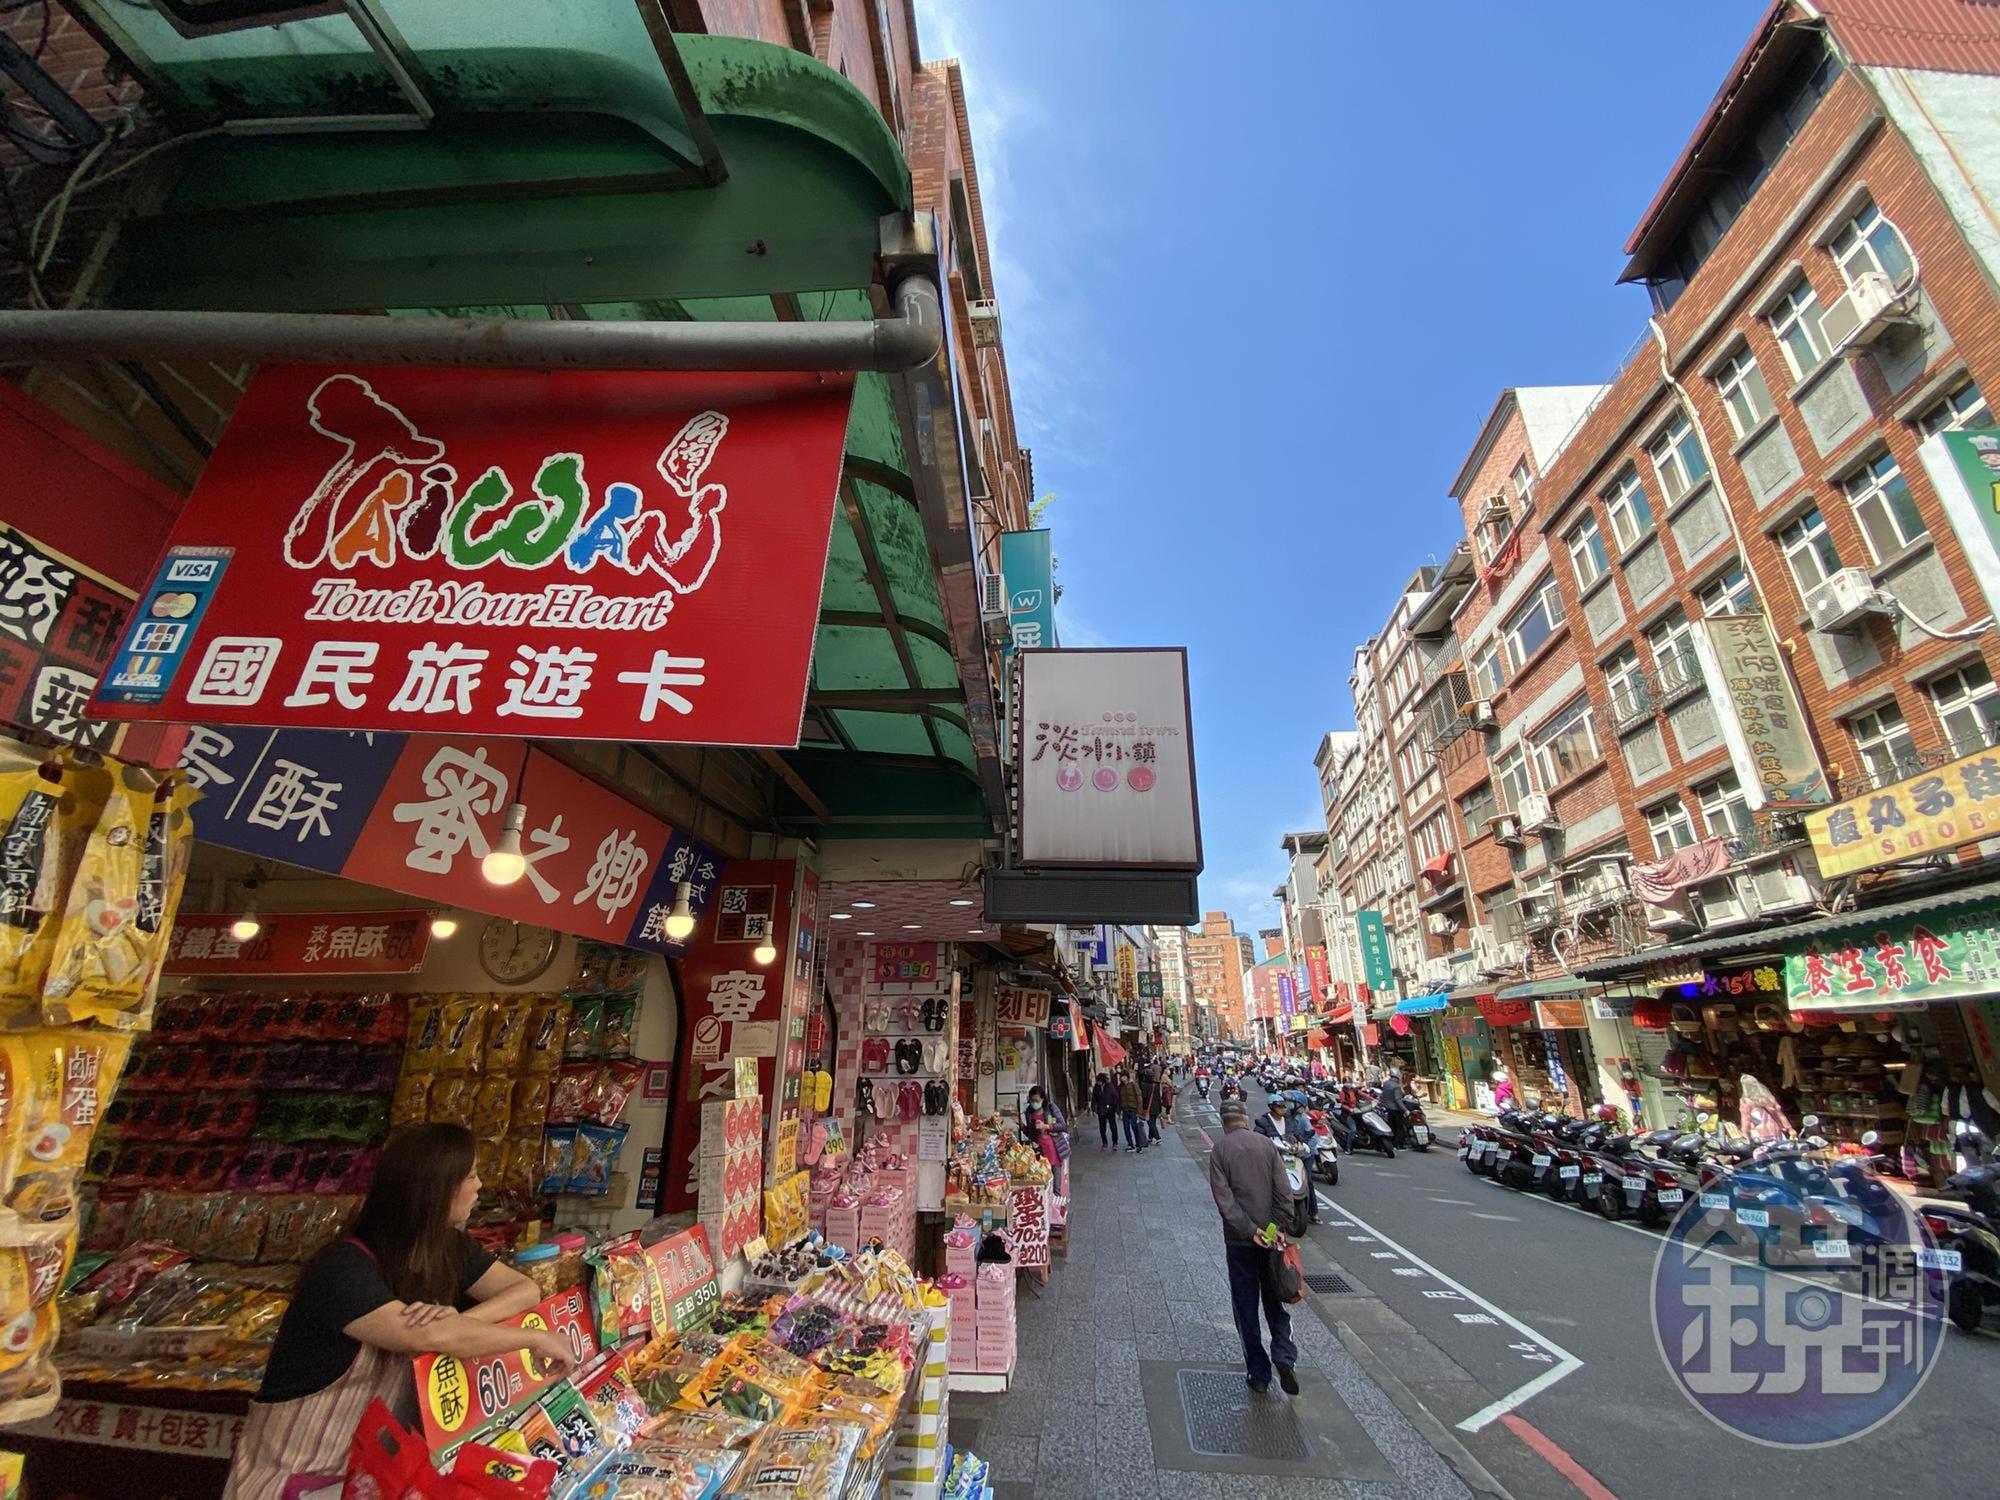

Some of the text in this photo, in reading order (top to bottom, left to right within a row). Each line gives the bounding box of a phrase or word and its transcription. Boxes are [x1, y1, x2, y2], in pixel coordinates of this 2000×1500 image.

[175, 563, 212, 577] VISA
[308, 580, 674, 631] Touch Your Heart
[141, 632, 174, 642] JCB
[188, 637, 706, 722] 國民旅遊卡
[1032, 722, 1156, 763] 淡水小鎮
[393, 745, 648, 927] 蜜之鄉
[302, 924, 329, 963] 淡水
[323, 925, 389, 958] 魚酥
[1805, 924, 1952, 997] 養生素食
[997, 989, 1050, 1023] 刻印
[63, 1045, 102, 1126] 鹹蛋
[826, 1137, 845, 1154] 390
[1014, 1227, 1046, 1243] 70元
[434, 1354, 464, 1426] 魚酥
